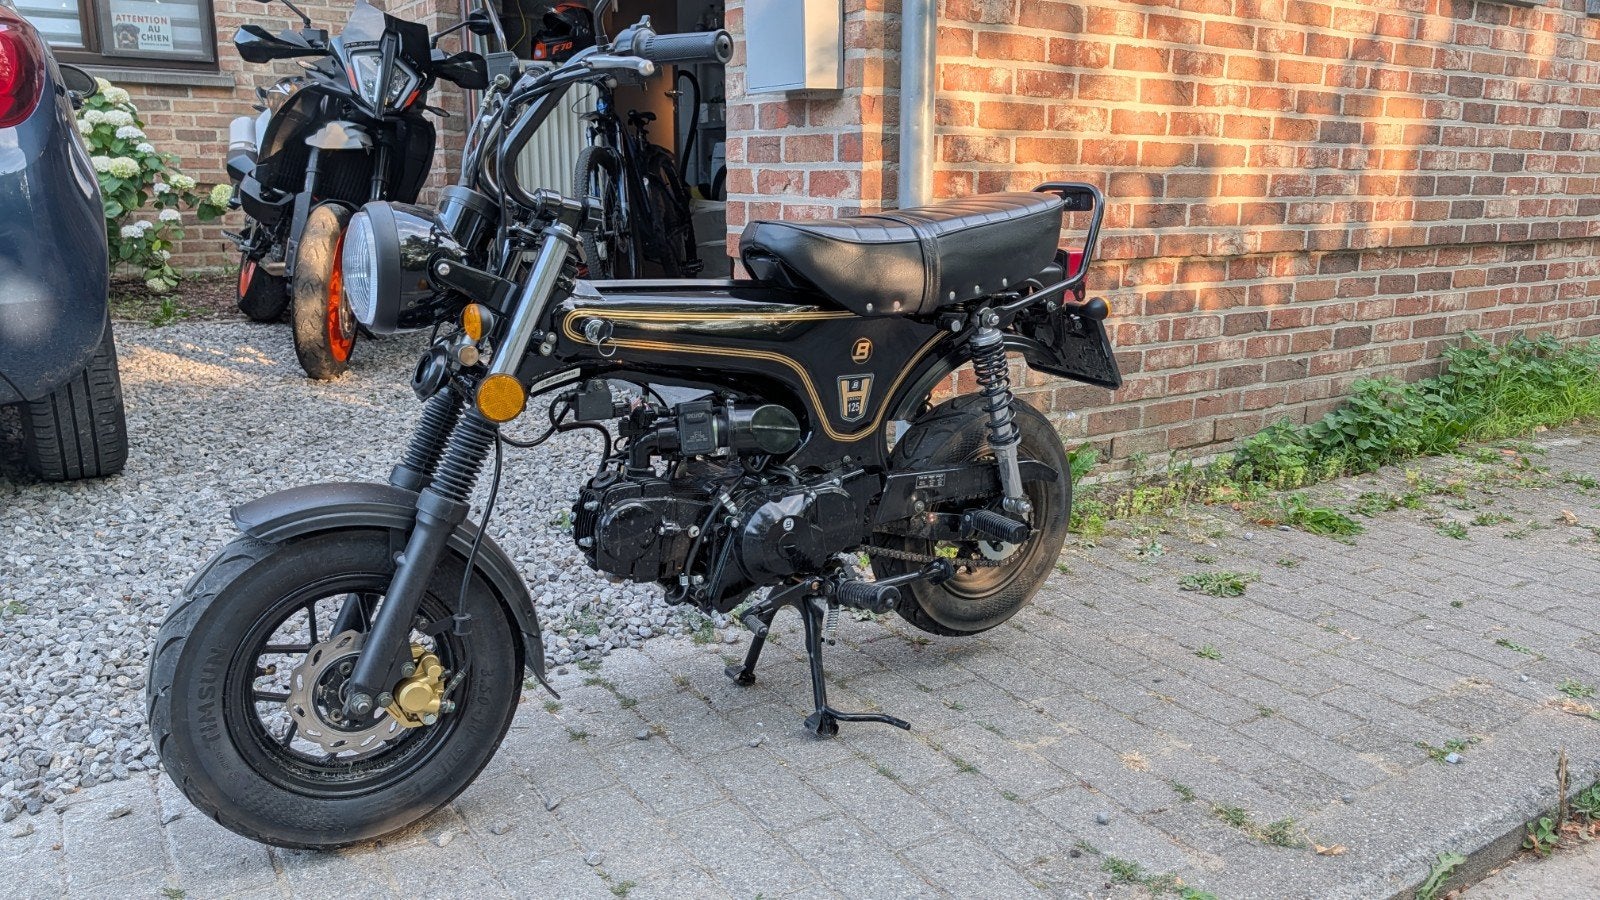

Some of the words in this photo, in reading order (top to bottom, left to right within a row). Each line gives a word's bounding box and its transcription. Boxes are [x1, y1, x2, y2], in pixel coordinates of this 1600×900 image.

[115, 14, 168, 24] ATTENTION
[148, 25, 160, 33] AU
[141, 33, 169, 42] CHIEN
[848, 402, 860, 412] 125
[197, 647, 226, 749] TIMSUN
